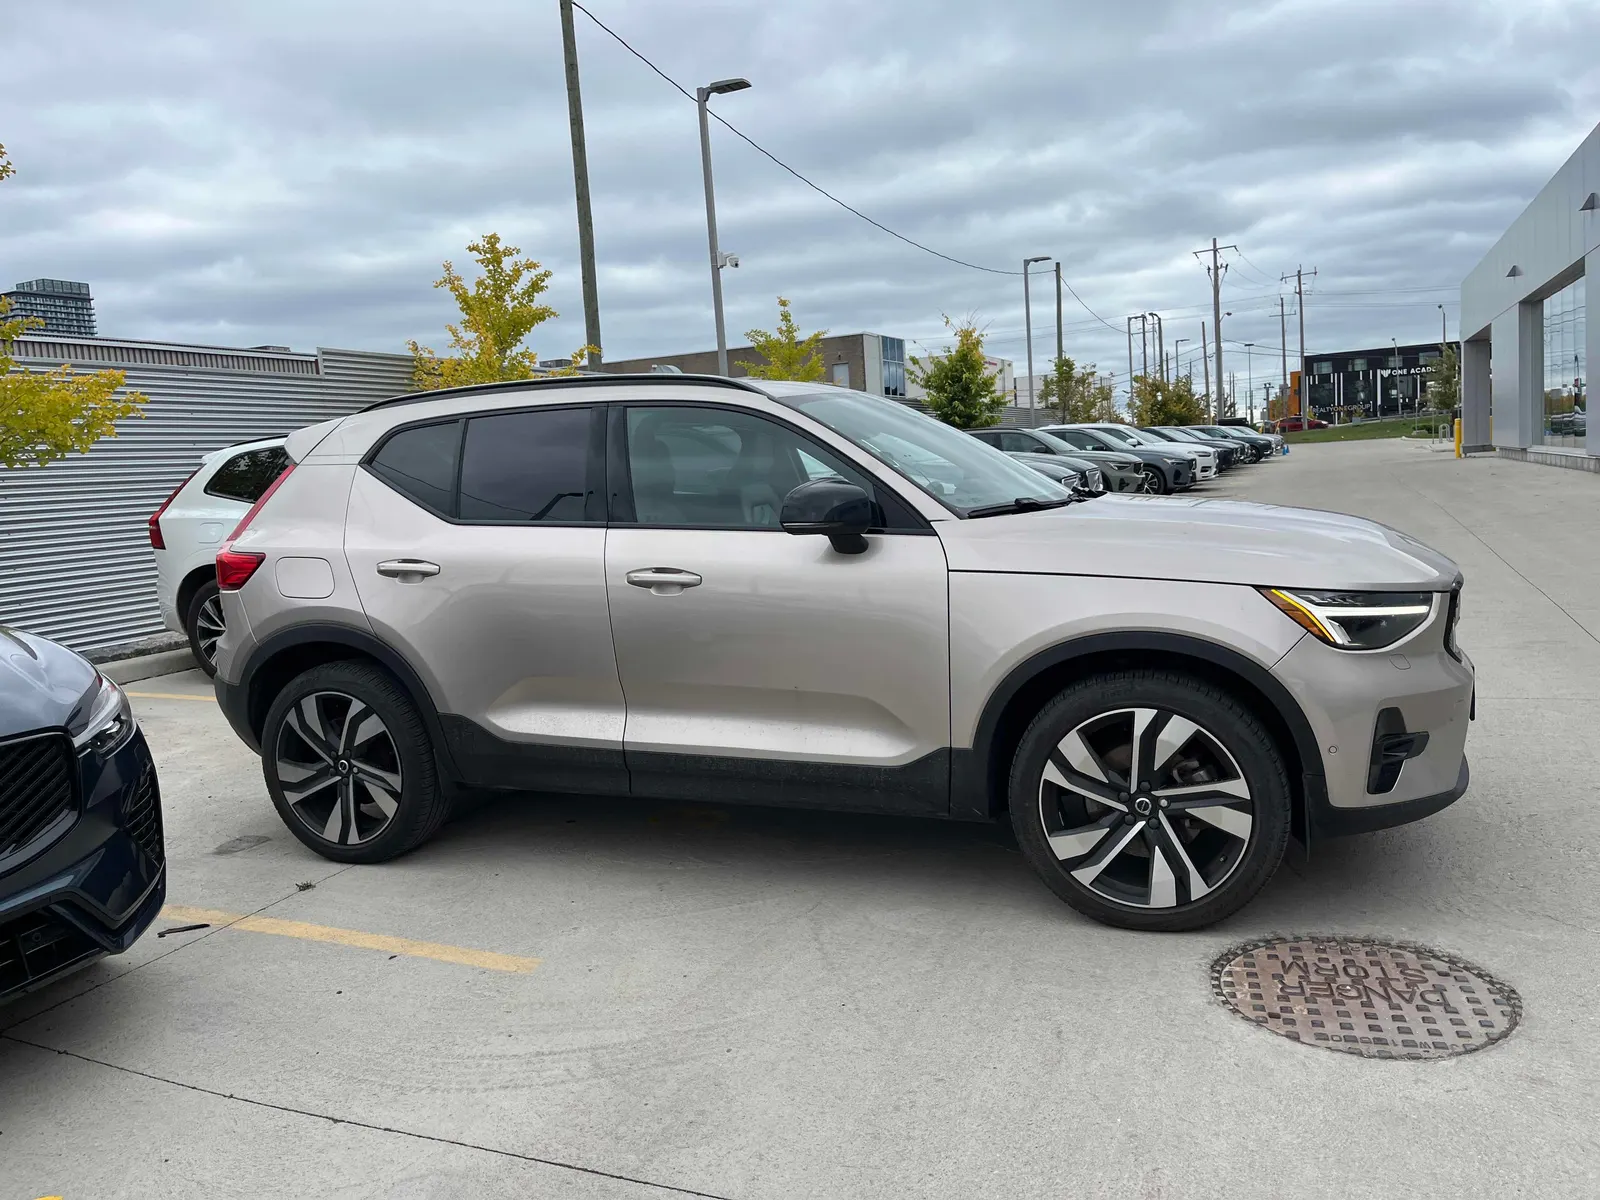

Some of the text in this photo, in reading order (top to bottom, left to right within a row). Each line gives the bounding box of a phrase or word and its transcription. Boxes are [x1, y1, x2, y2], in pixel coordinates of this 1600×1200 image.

[1391, 368, 1408, 376] ONE
[1280, 960, 1429, 984] STORM
[1279, 979, 1450, 1007] DANGER
